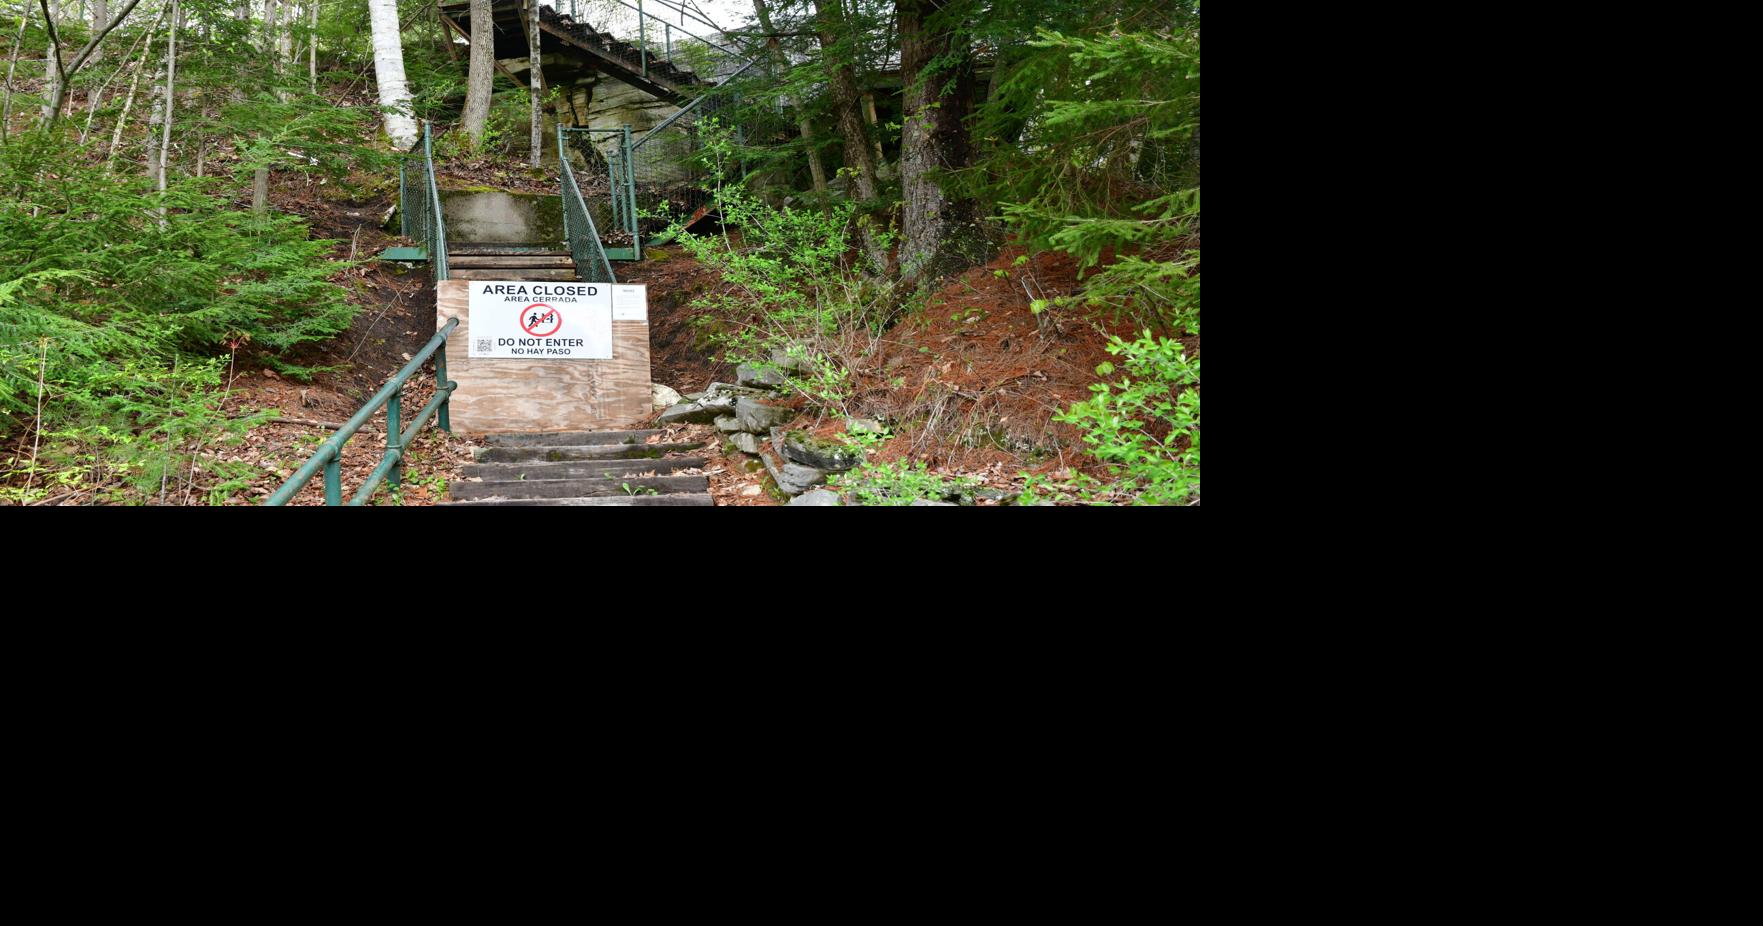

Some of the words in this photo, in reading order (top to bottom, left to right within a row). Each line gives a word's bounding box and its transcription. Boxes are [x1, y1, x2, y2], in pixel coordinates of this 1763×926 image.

[483, 285, 527, 295] AREA
[533, 286, 598, 296] CLOSED
[498, 338, 515, 346] DO
[519, 338, 542, 346] NOT
[546, 339, 584, 347] ENTER
